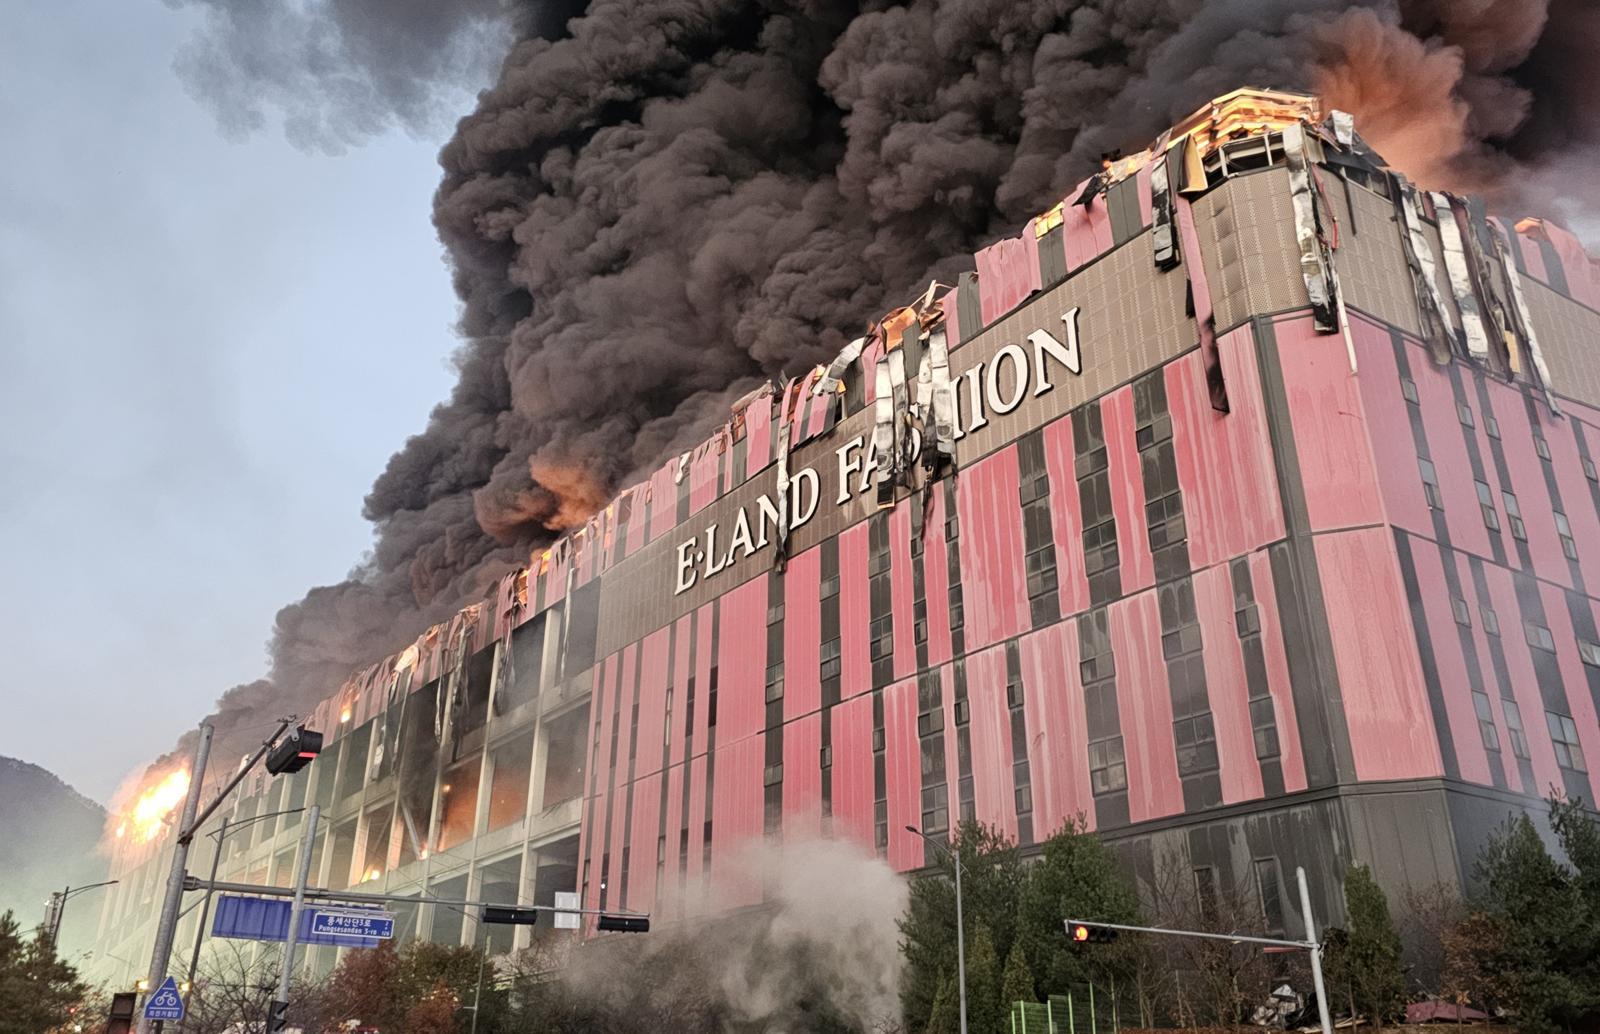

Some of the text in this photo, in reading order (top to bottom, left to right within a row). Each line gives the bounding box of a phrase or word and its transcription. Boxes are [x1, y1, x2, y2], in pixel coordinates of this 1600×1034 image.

[327, 916, 372, 927] 풍세산단3로
[318, 924, 378, 936] Pungsesandan 3-ro
